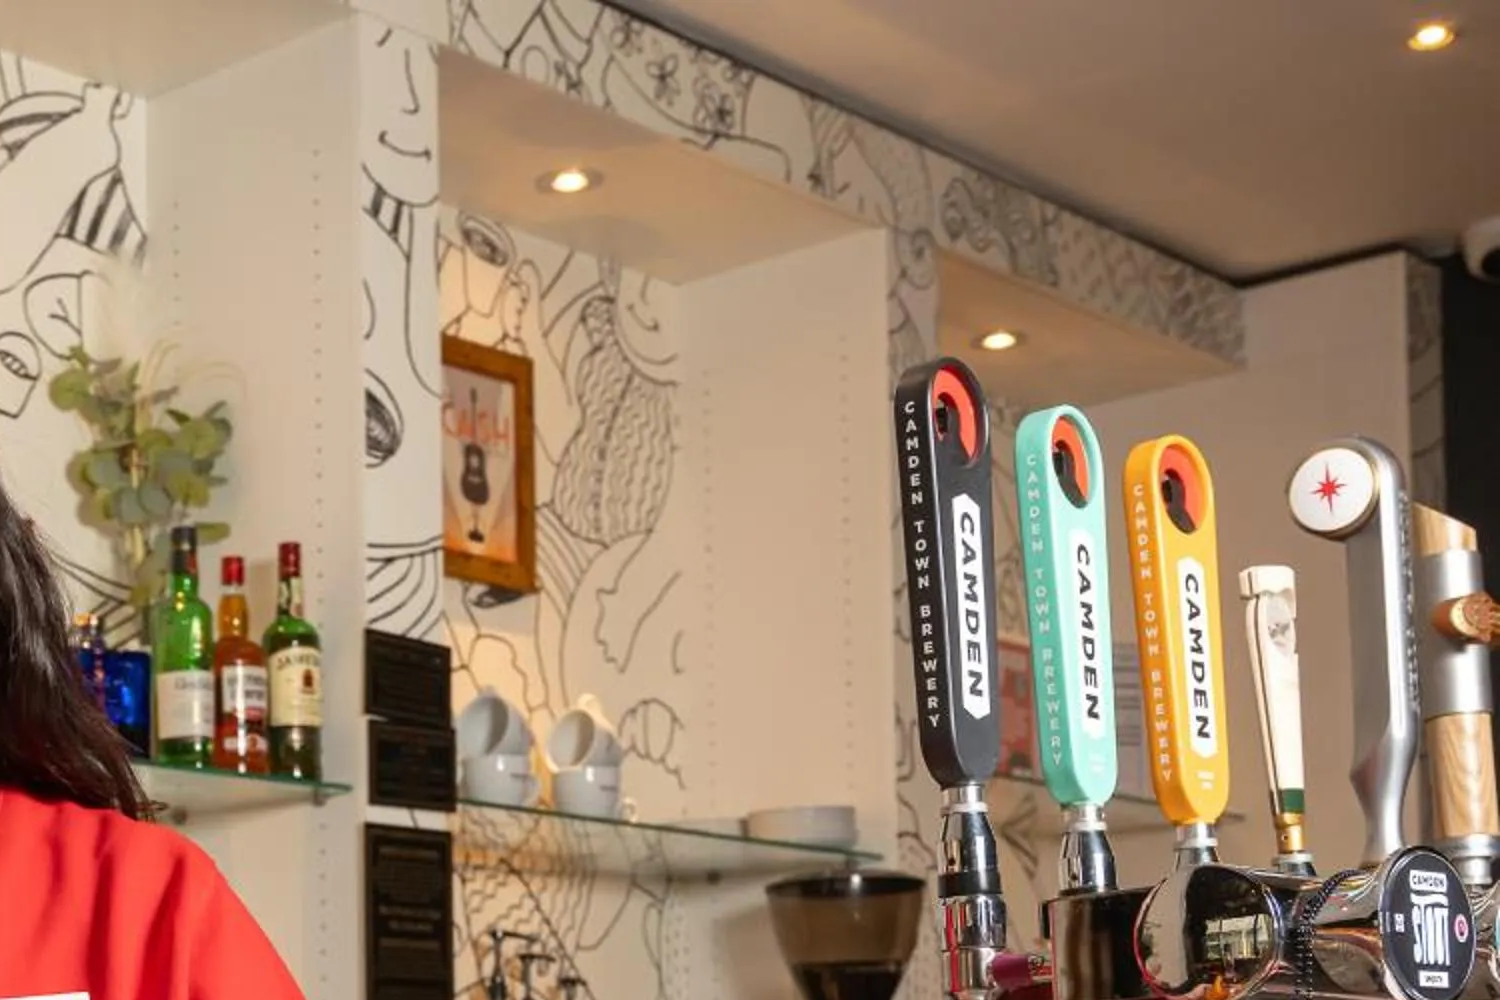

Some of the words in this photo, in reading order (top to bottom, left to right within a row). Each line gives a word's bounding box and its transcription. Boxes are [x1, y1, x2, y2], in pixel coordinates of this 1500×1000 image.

[902, 400, 923, 506] CAMDEN
[1026, 453, 1045, 554] CAMDEN
[914, 519, 931, 589] TOWN
[959, 510, 984, 699] CAMDEN
[1034, 567, 1051, 634] TOWN
[920, 604, 941, 729] BREWERY
[1076, 542, 1101, 722] CAMDEN
[1133, 483, 1153, 579] CAMDEN
[1144, 591, 1160, 657] TOWN
[1152, 670, 1172, 783] BREWERY
[1184, 572, 1212, 740] CAMDEN
[1041, 648, 1062, 768] BREWERY
[1410, 893, 1450, 967] STOUT
[1411, 873, 1446, 890] CAMDEN
